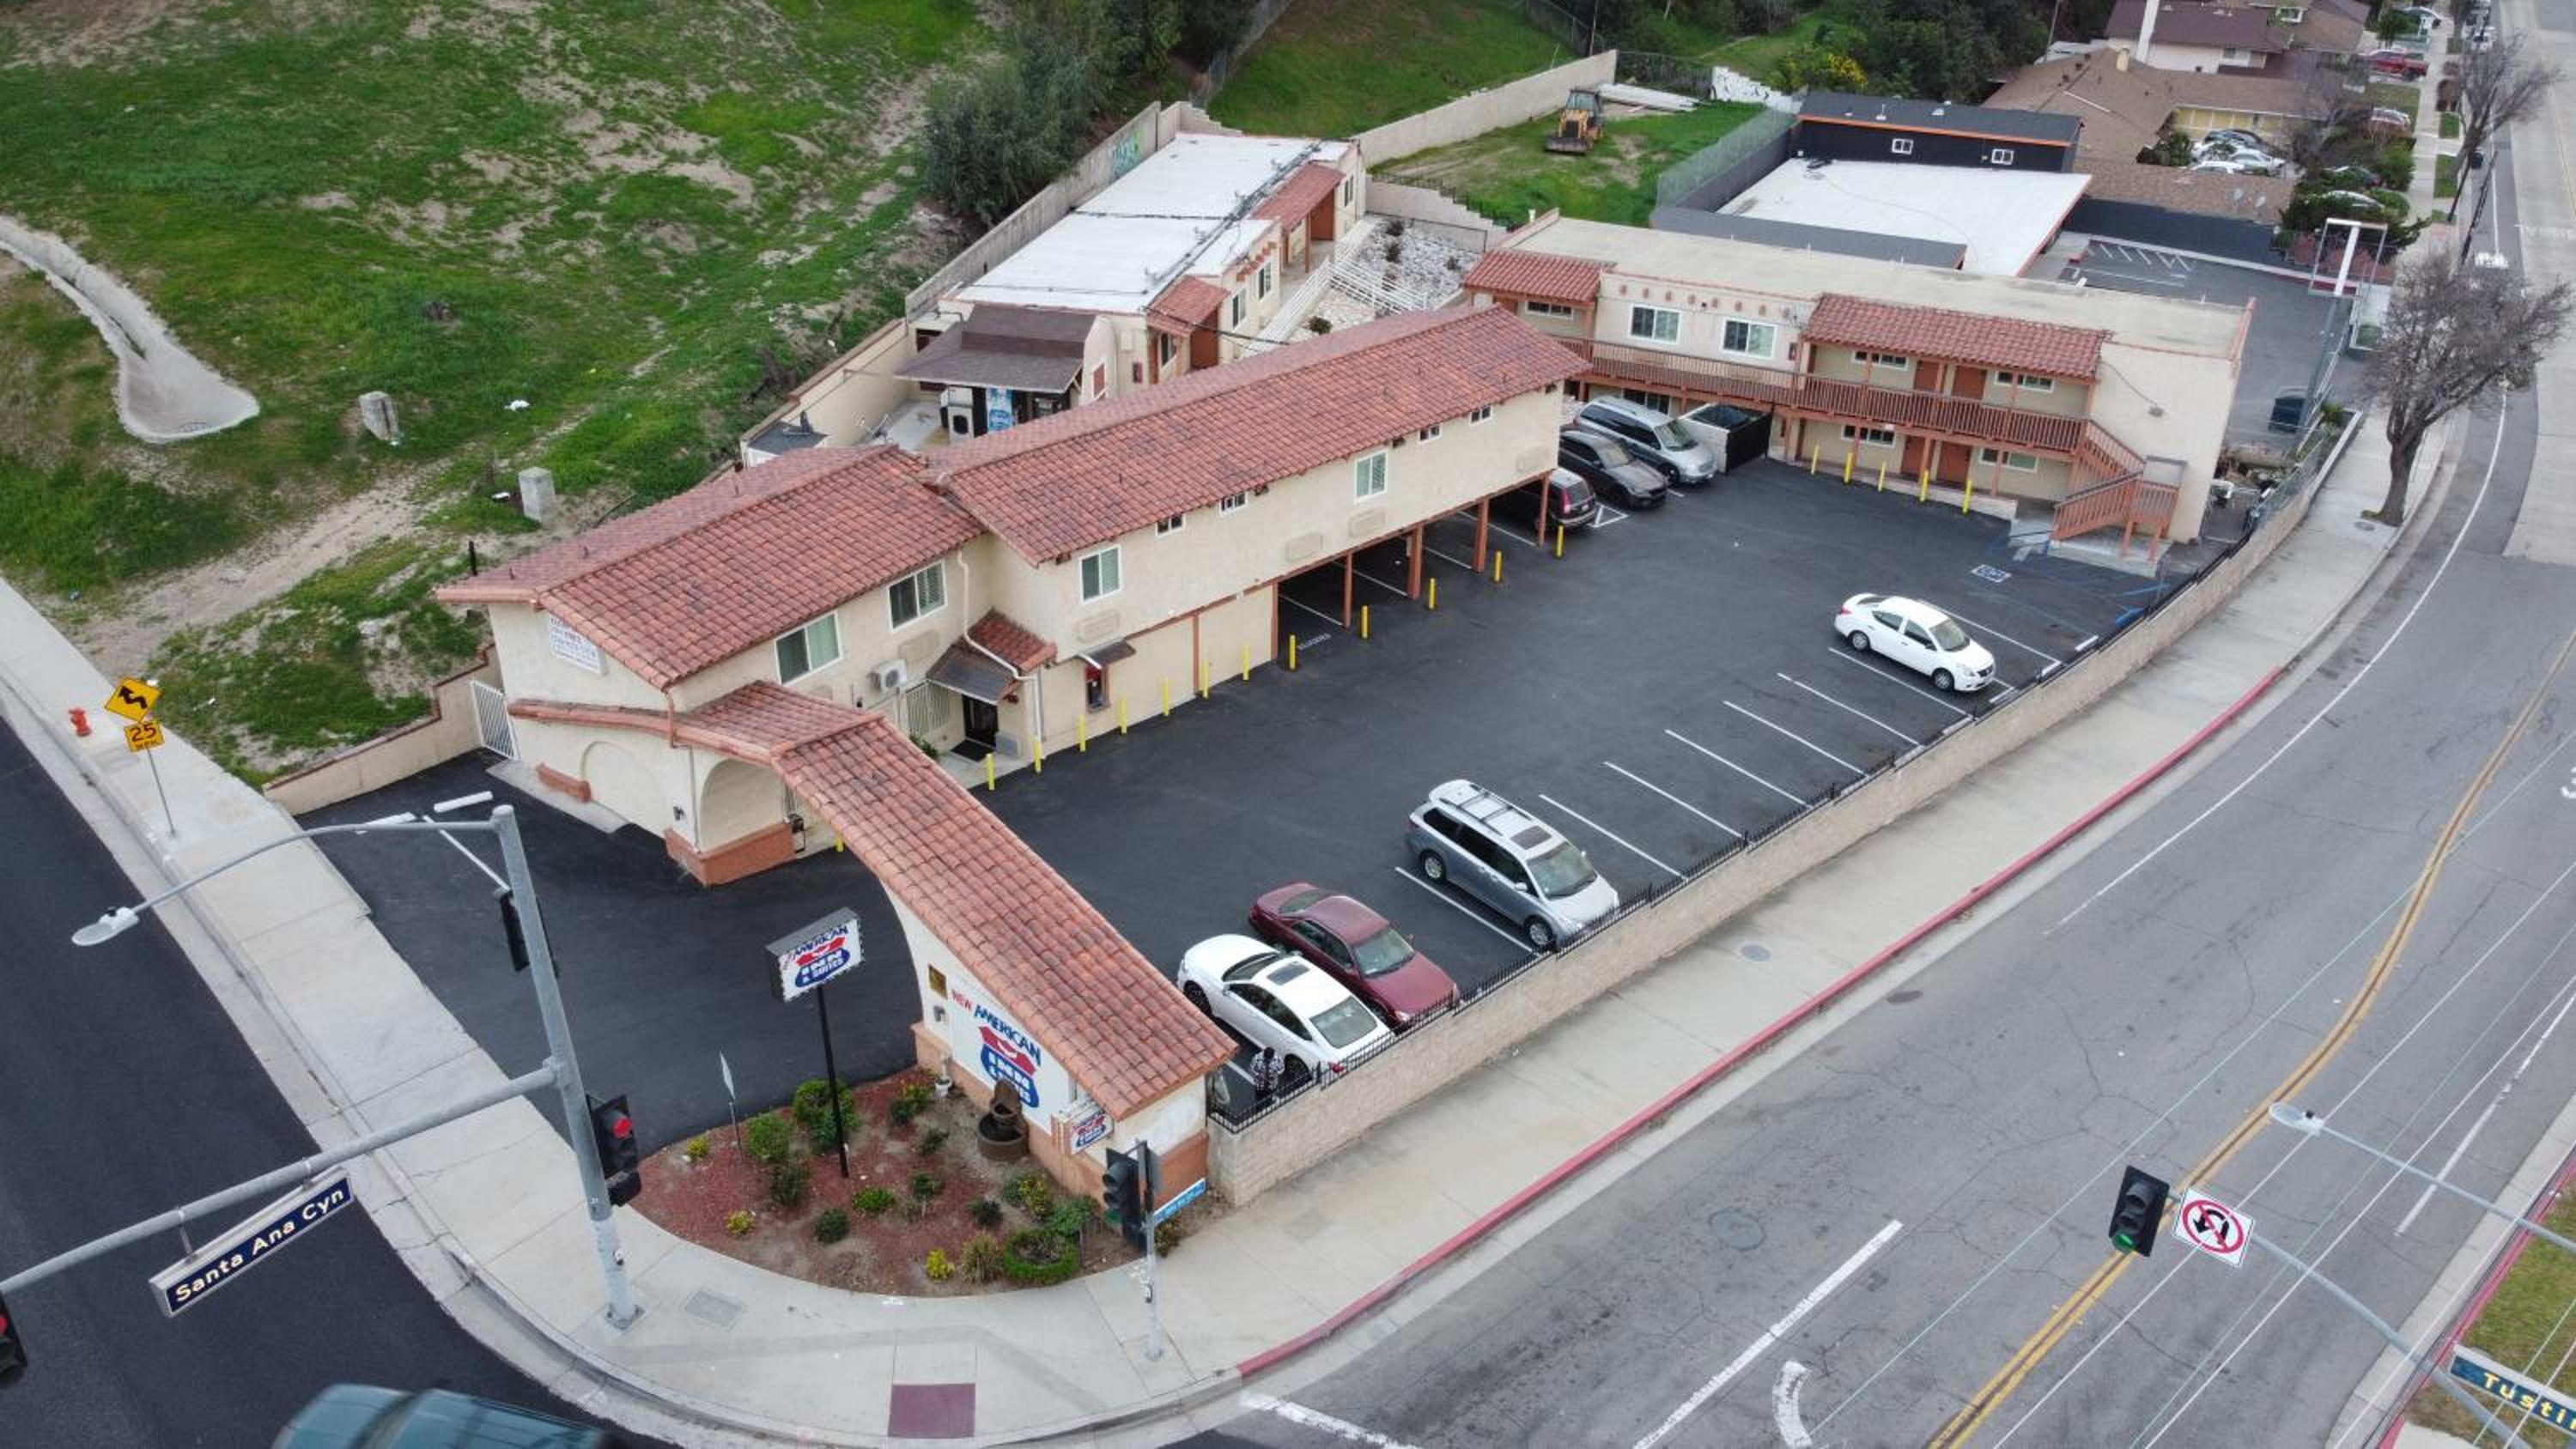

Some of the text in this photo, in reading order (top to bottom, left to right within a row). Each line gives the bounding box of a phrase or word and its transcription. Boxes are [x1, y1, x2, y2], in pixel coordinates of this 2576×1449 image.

[130, 722, 157, 742] 25
[136, 739, 157, 749] MPH
[796, 925, 848, 955] AMERICAN
[801, 949, 842, 974] INN
[952, 990, 1042, 1066] NEW AMERICAN
[988, 1051, 1030, 1089] INN
[175, 1188, 344, 1301] Santa Ana Cyn
